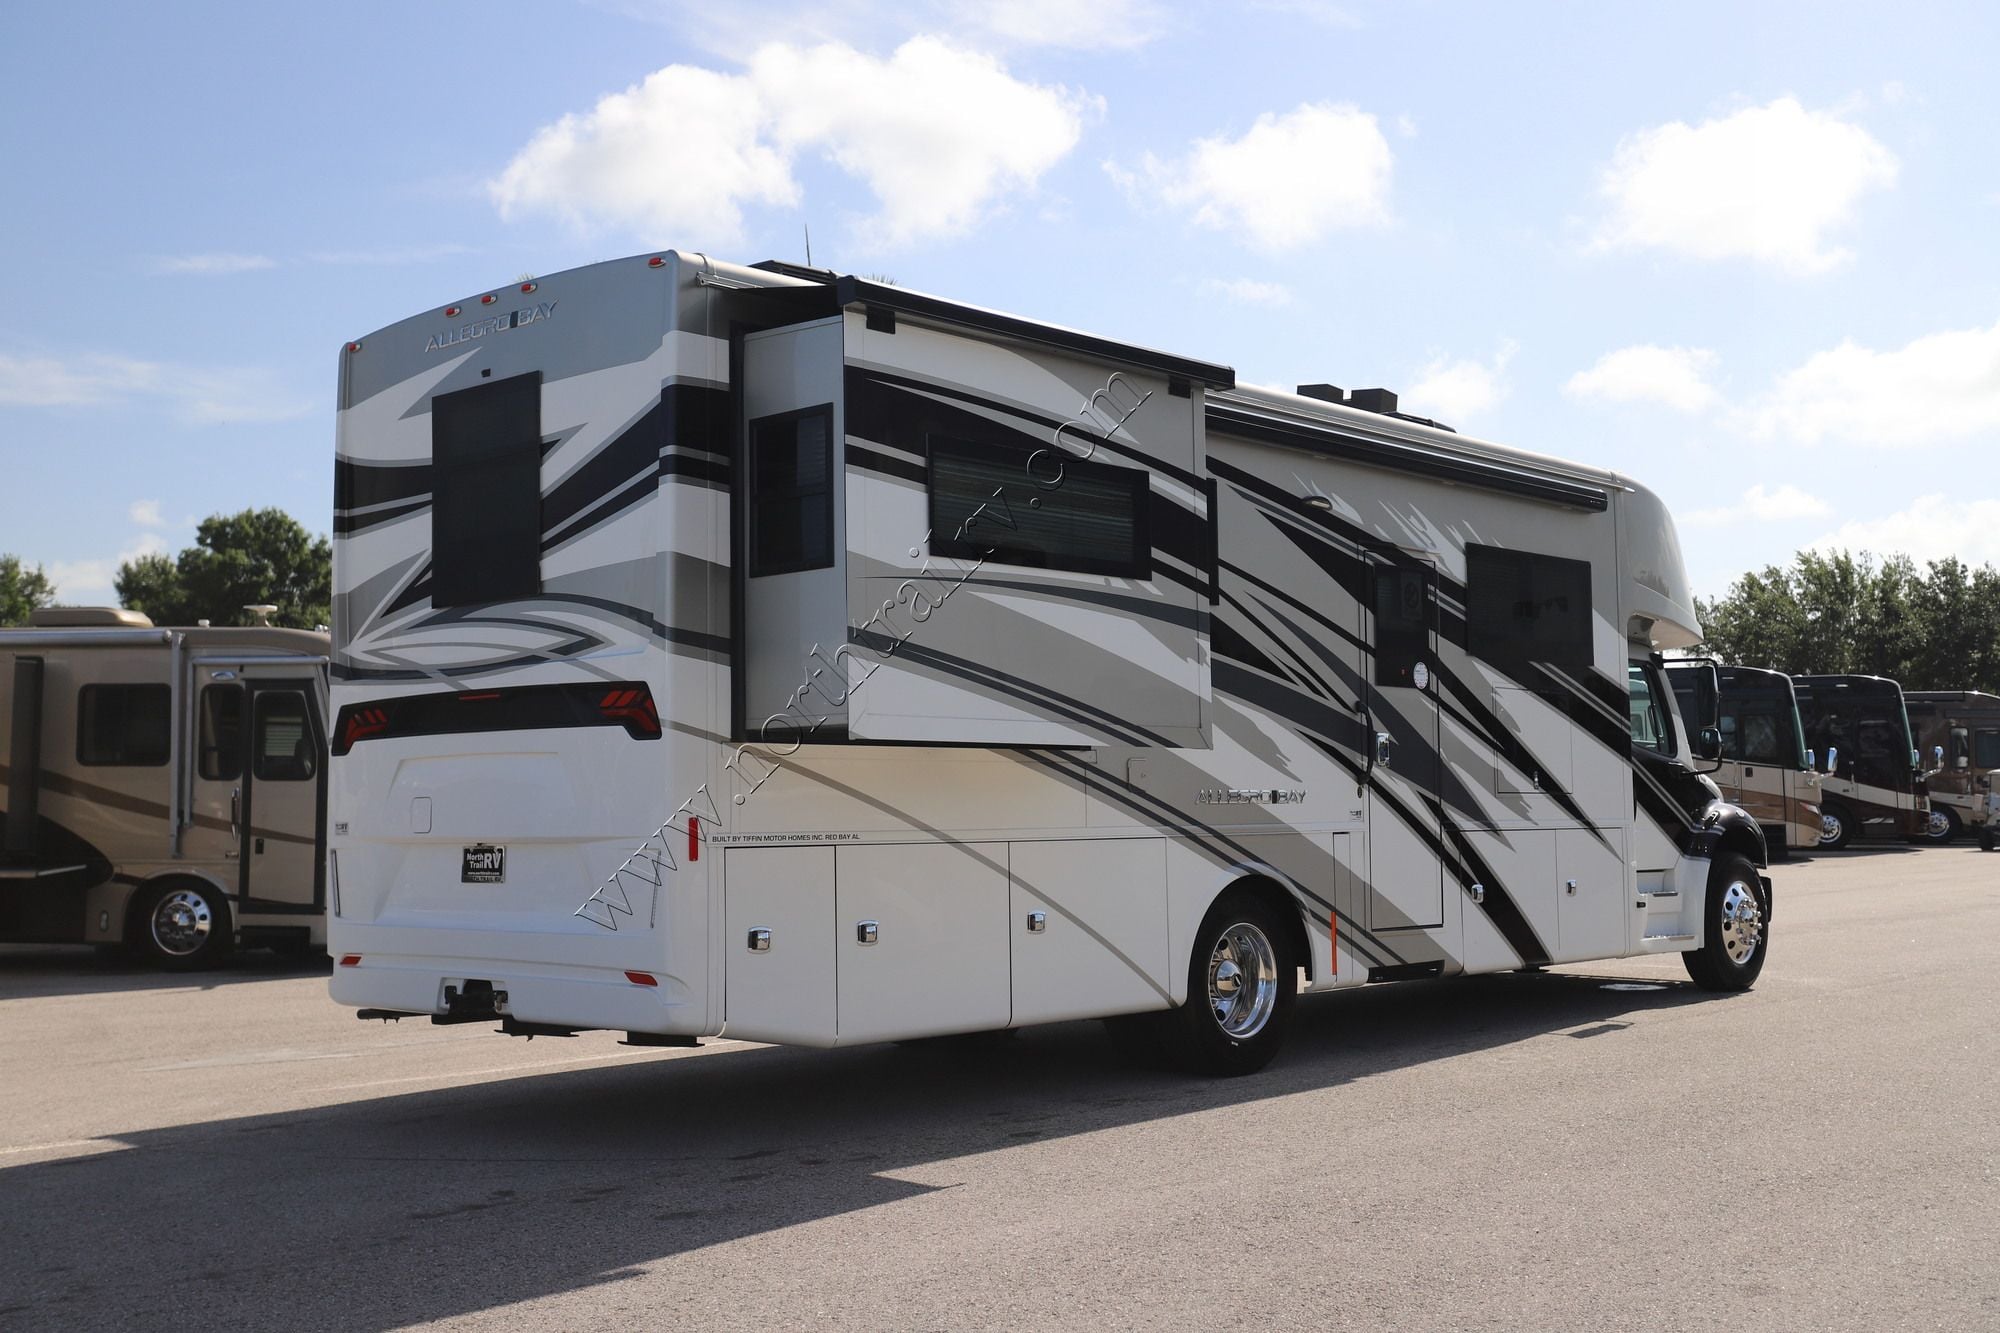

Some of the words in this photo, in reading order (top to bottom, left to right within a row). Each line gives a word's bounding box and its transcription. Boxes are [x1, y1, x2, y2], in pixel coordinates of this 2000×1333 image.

[425, 313, 511, 352] ALLEGRO
[517, 300, 560, 327] BAY
[1195, 790, 1272, 805] ALLEGRO
[1278, 789, 1306, 804] BAY
[712, 835, 731, 843] BUILT
[764, 834, 787, 842] MOTOR
[466, 853, 484, 861] North
[484, 853, 502, 869] RV
[470, 861, 484, 869] Trail
